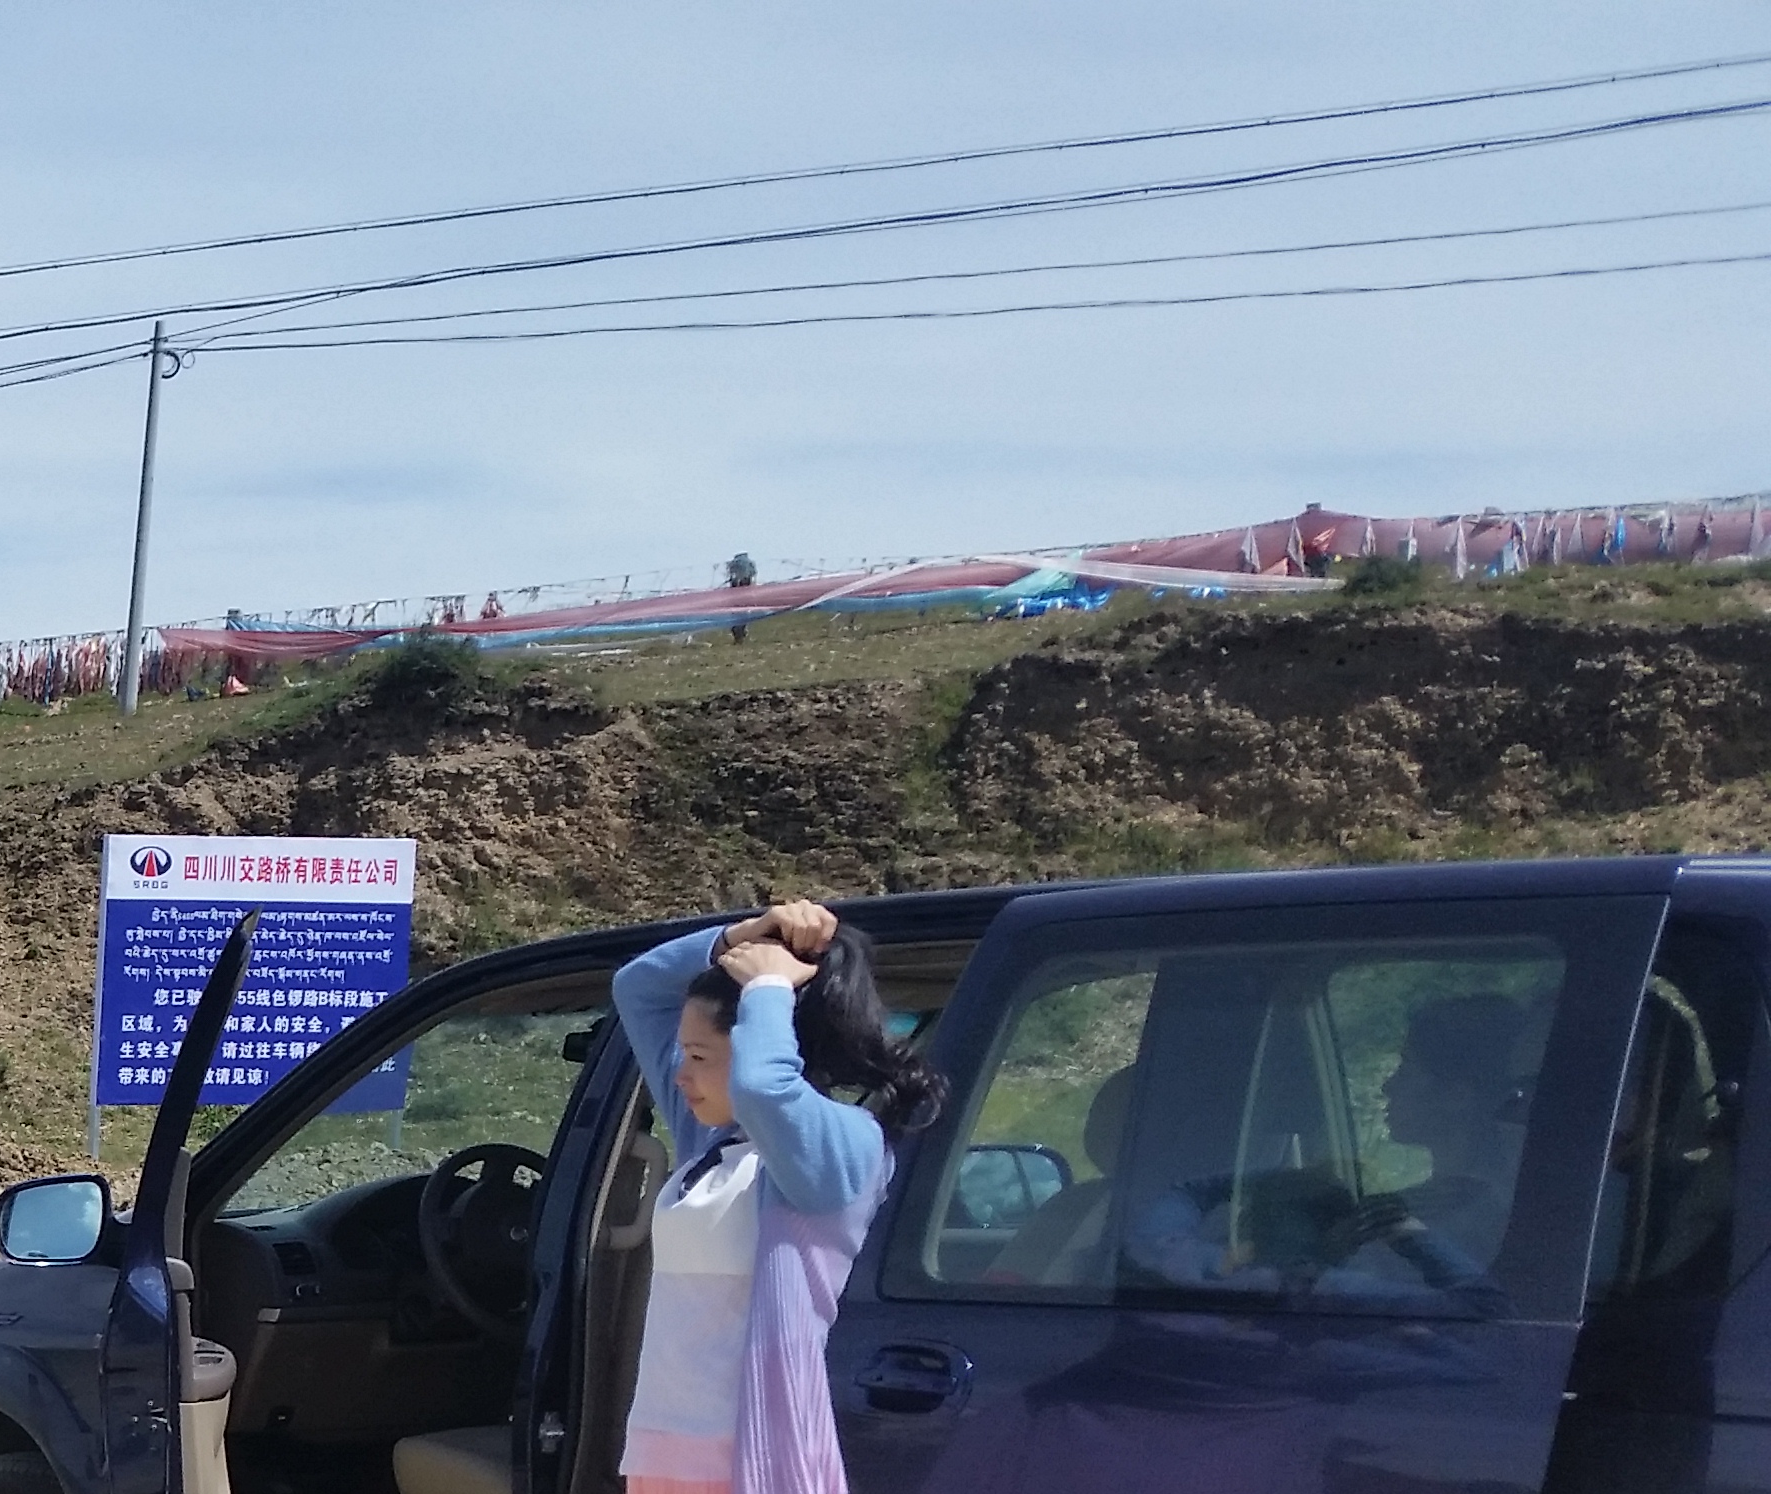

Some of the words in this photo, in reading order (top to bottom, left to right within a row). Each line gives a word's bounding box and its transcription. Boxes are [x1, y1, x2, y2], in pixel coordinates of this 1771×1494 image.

[183, 855, 399, 886] 四川川交路桥有限责任公司
